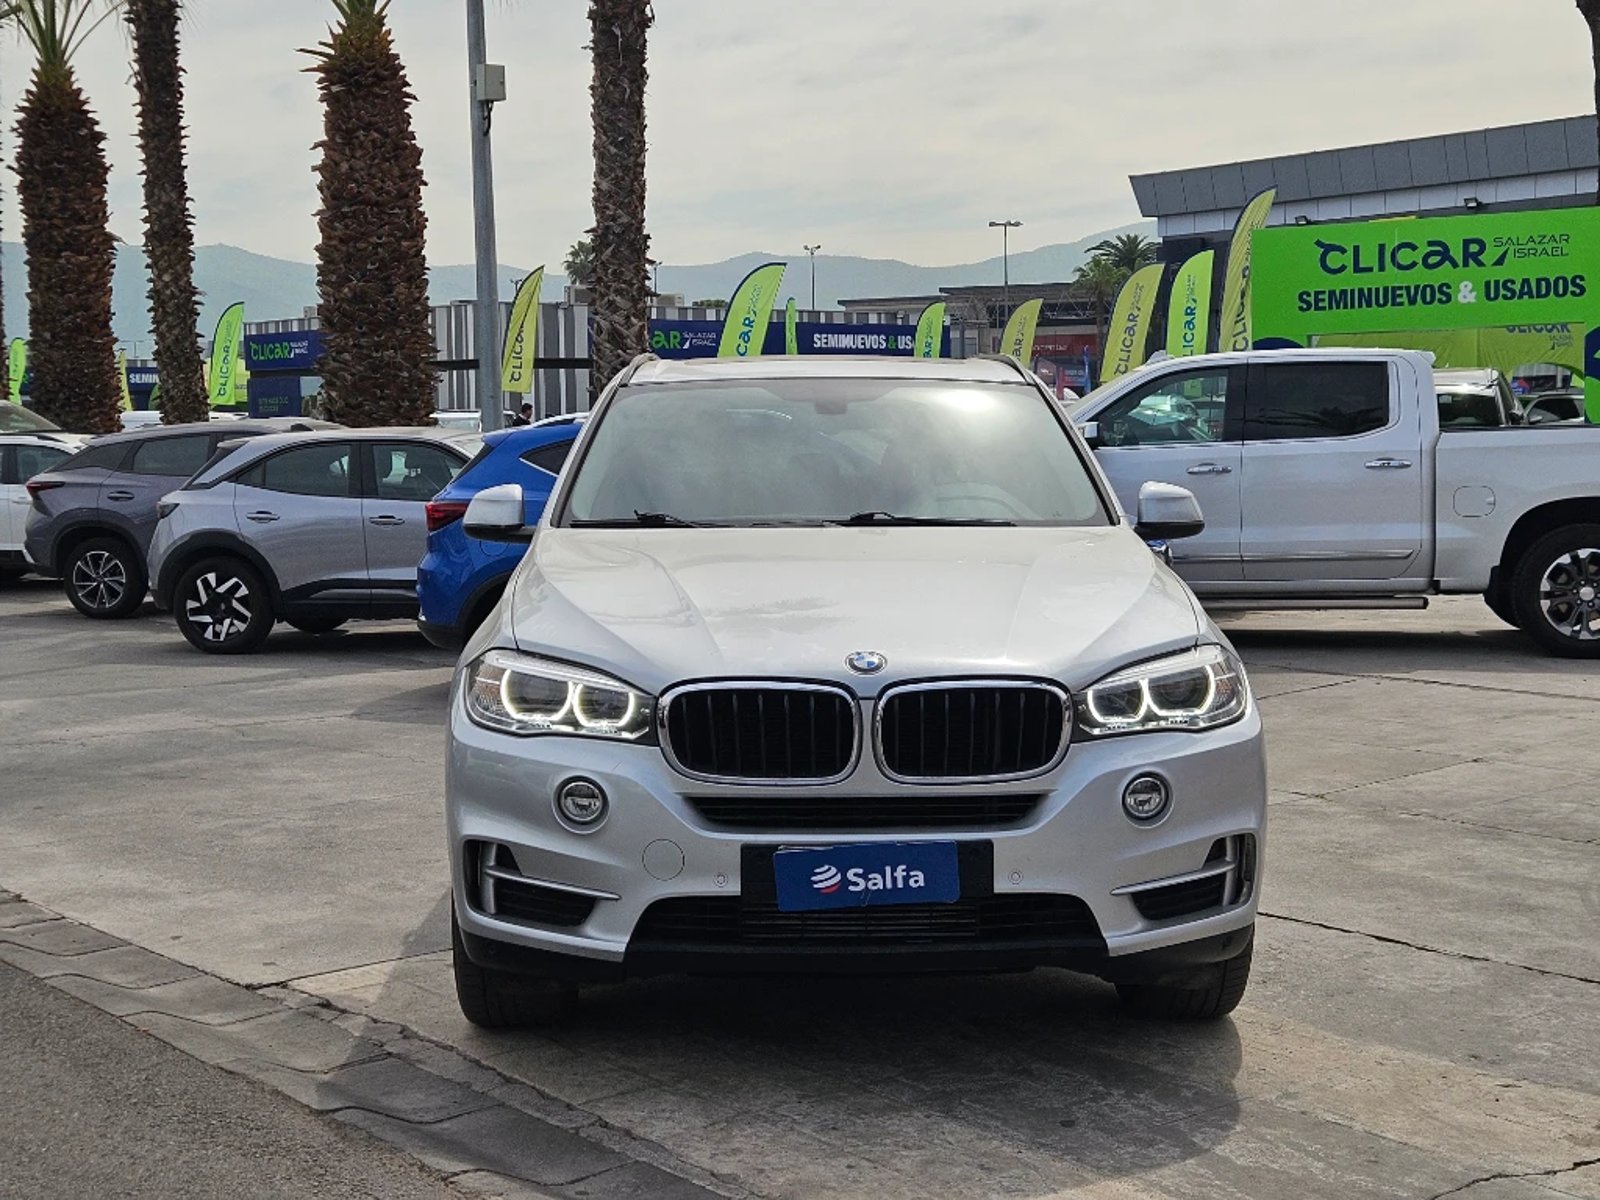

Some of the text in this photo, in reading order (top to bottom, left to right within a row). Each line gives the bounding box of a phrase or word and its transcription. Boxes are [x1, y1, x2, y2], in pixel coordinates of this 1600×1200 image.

[1493, 234, 1570, 248] SALAZAR
[1513, 247, 1570, 259] ISRAEL
[1298, 275, 1587, 312] SEMINUEVOS & USADOS
[813, 333, 887, 349] SEMINUEVOS
[846, 865, 925, 892] Salfa
